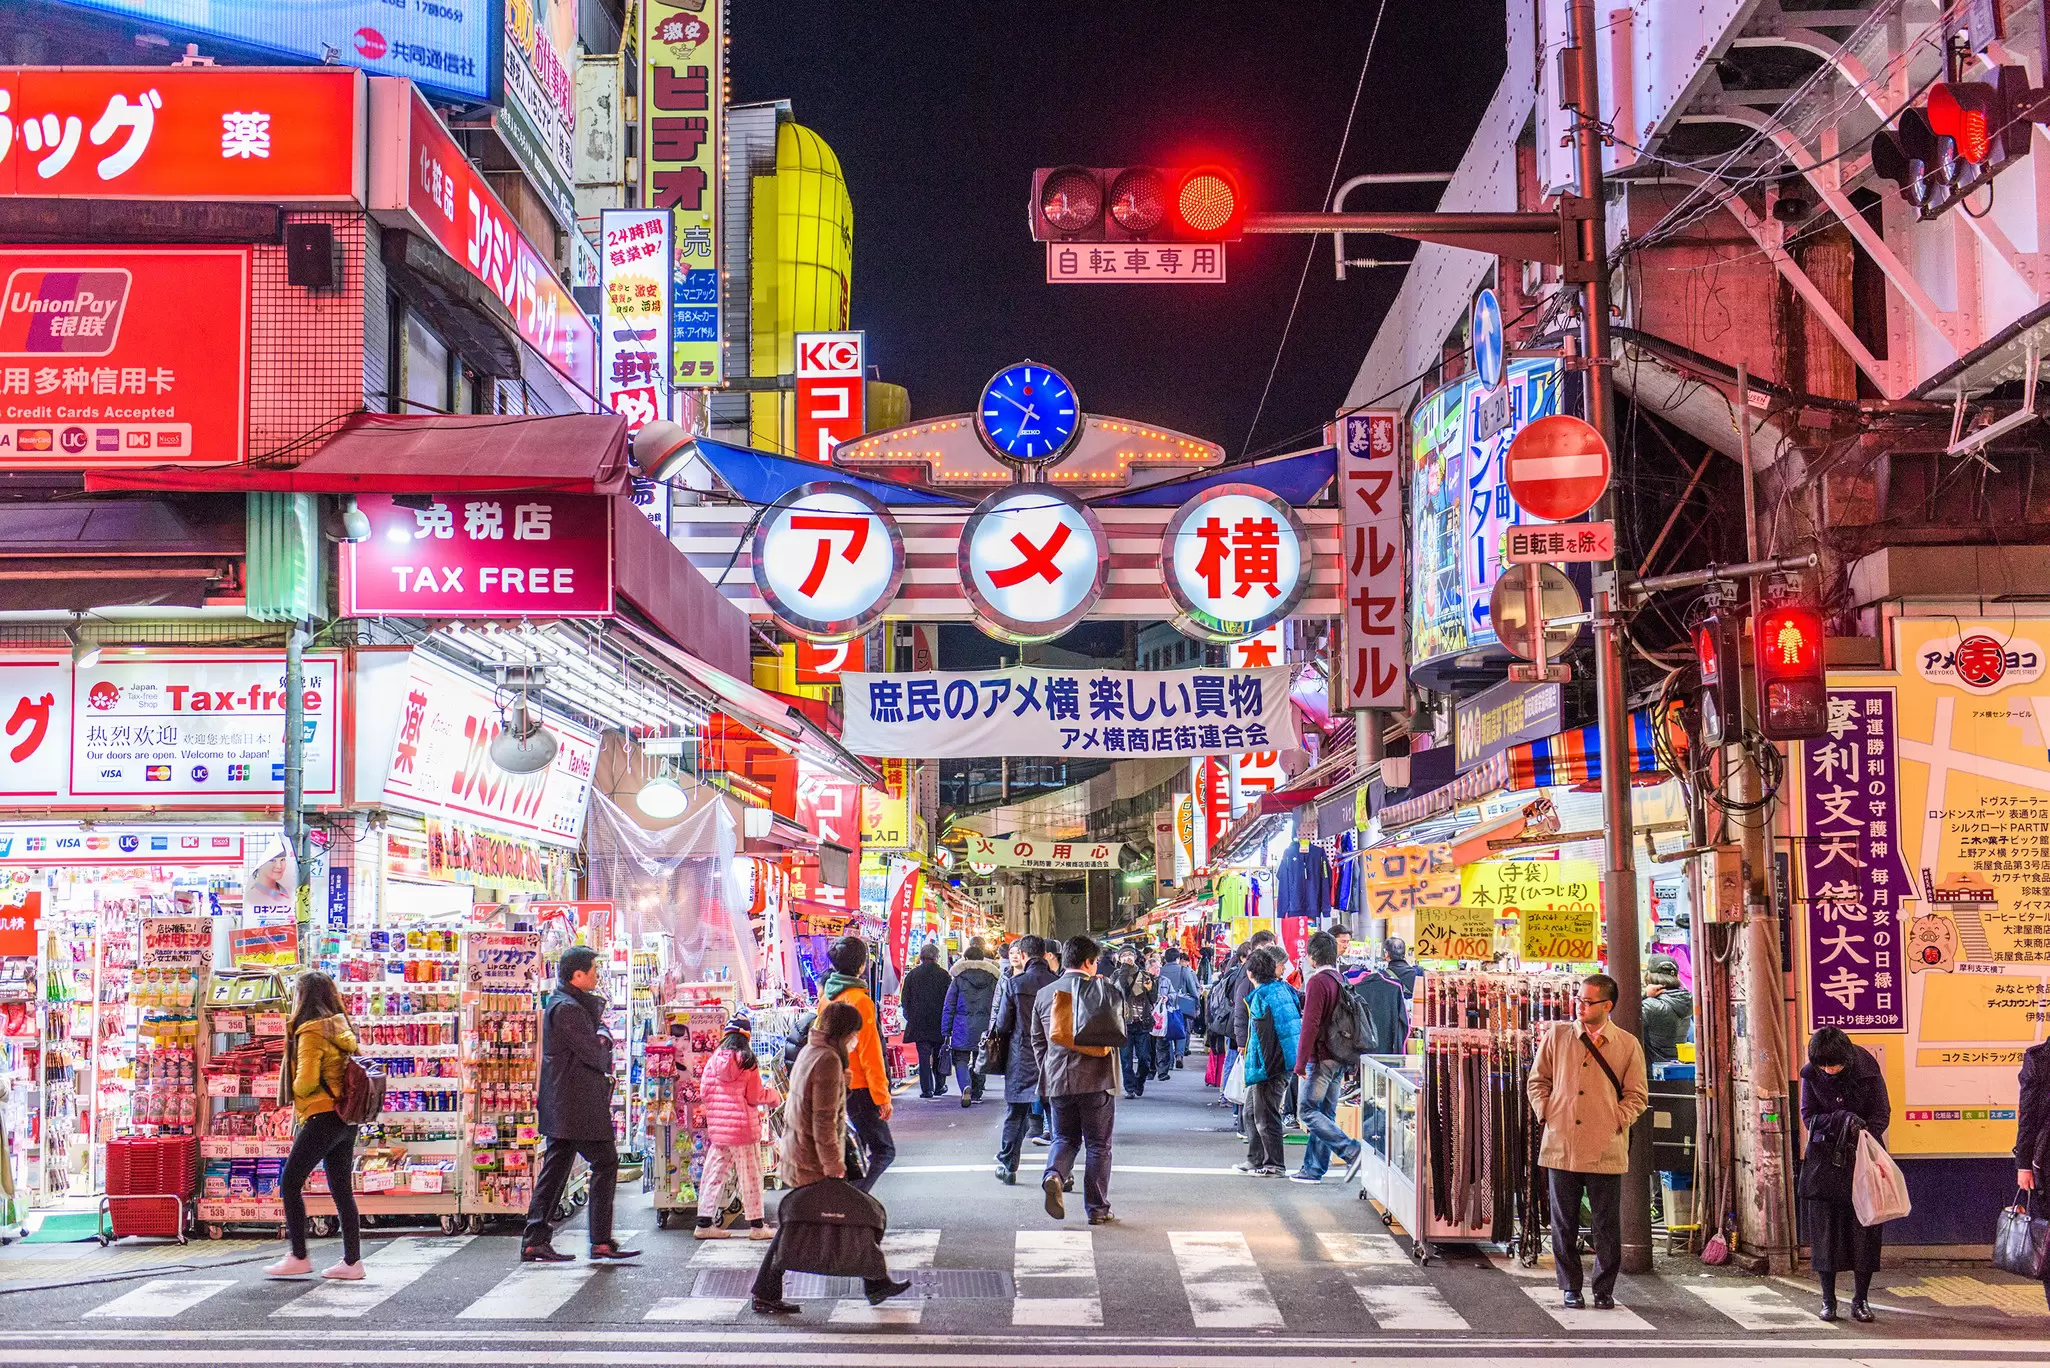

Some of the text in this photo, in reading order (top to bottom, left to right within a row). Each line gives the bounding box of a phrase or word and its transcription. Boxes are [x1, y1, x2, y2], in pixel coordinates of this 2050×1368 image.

[663, 21, 701, 40] 激安
[392, 40, 475, 77] 共同通信社
[221, 112, 271, 159] 薬
[419, 143, 455, 223] 化粧品
[608, 218, 663, 247] 24時間
[1059, 247, 1216, 274] 自転車専用
[468, 188, 557, 357] コクミンドラッグ
[11, 292, 117, 320] UnionPay
[50, 316, 105, 337] 银联
[802, 340, 858, 371] KG
[674, 361, 715, 376] タラ
[0, 366, 175, 396] 用多种信用卡
[7, 406, 175, 420] Credit Cards Accepted
[128, 434, 149, 447] DC
[414, 501, 553, 542] 免税店
[1513, 531, 1608, 556] 自転車を除く
[392, 566, 574, 594] TAX FREE
[1348, 470, 1399, 698] マルセル
[130, 683, 158, 692] Japan.
[138, 700, 158, 709] Shop
[868, 675, 1263, 723] 庶民のアメ横 楽しい買物
[5, 692, 55, 763] グ
[86, 725, 178, 747] 热烈欢迎
[394, 689, 427, 775] 薬
[1061, 723, 1270, 755] アメ横商店街連合会
[86, 750, 270, 761] Our doors are open. Welcome to Japan!
[100, 769, 122, 778] VISA
[228, 767, 250, 778] JCB
[1929, 809, 2048, 819] ロンドンスポーツ 表通り店
[875, 830, 898, 842] 入口
[1951, 823, 2007, 833] シルクロード
[56, 838, 81, 848] VISA
[976, 838, 1109, 860] 火の用心
[1957, 848, 2050, 858] 上野アメ横 タワラ屋
[1382, 848, 1456, 878] ロンド
[1866, 698, 1893, 1010] 開運勝利の守護神 毎月亥の日縁日
[1973, 860, 2050, 871] 浜屋食品第3号店
[1992, 873, 2050, 883] カワチヤ食品
[1376, 880, 1461, 914] スポーツ
[2022, 886, 2050, 897] 珍味堂
[253, 905, 292, 914] ロキソニン
[1421, 923, 1457, 939] ベルト
[1959, 963, 2006, 974] 摩利支天横丁
[1817, 1015, 1899, 1026] ココより徒歩30秒
[215, 1146, 228, 1154] 792
